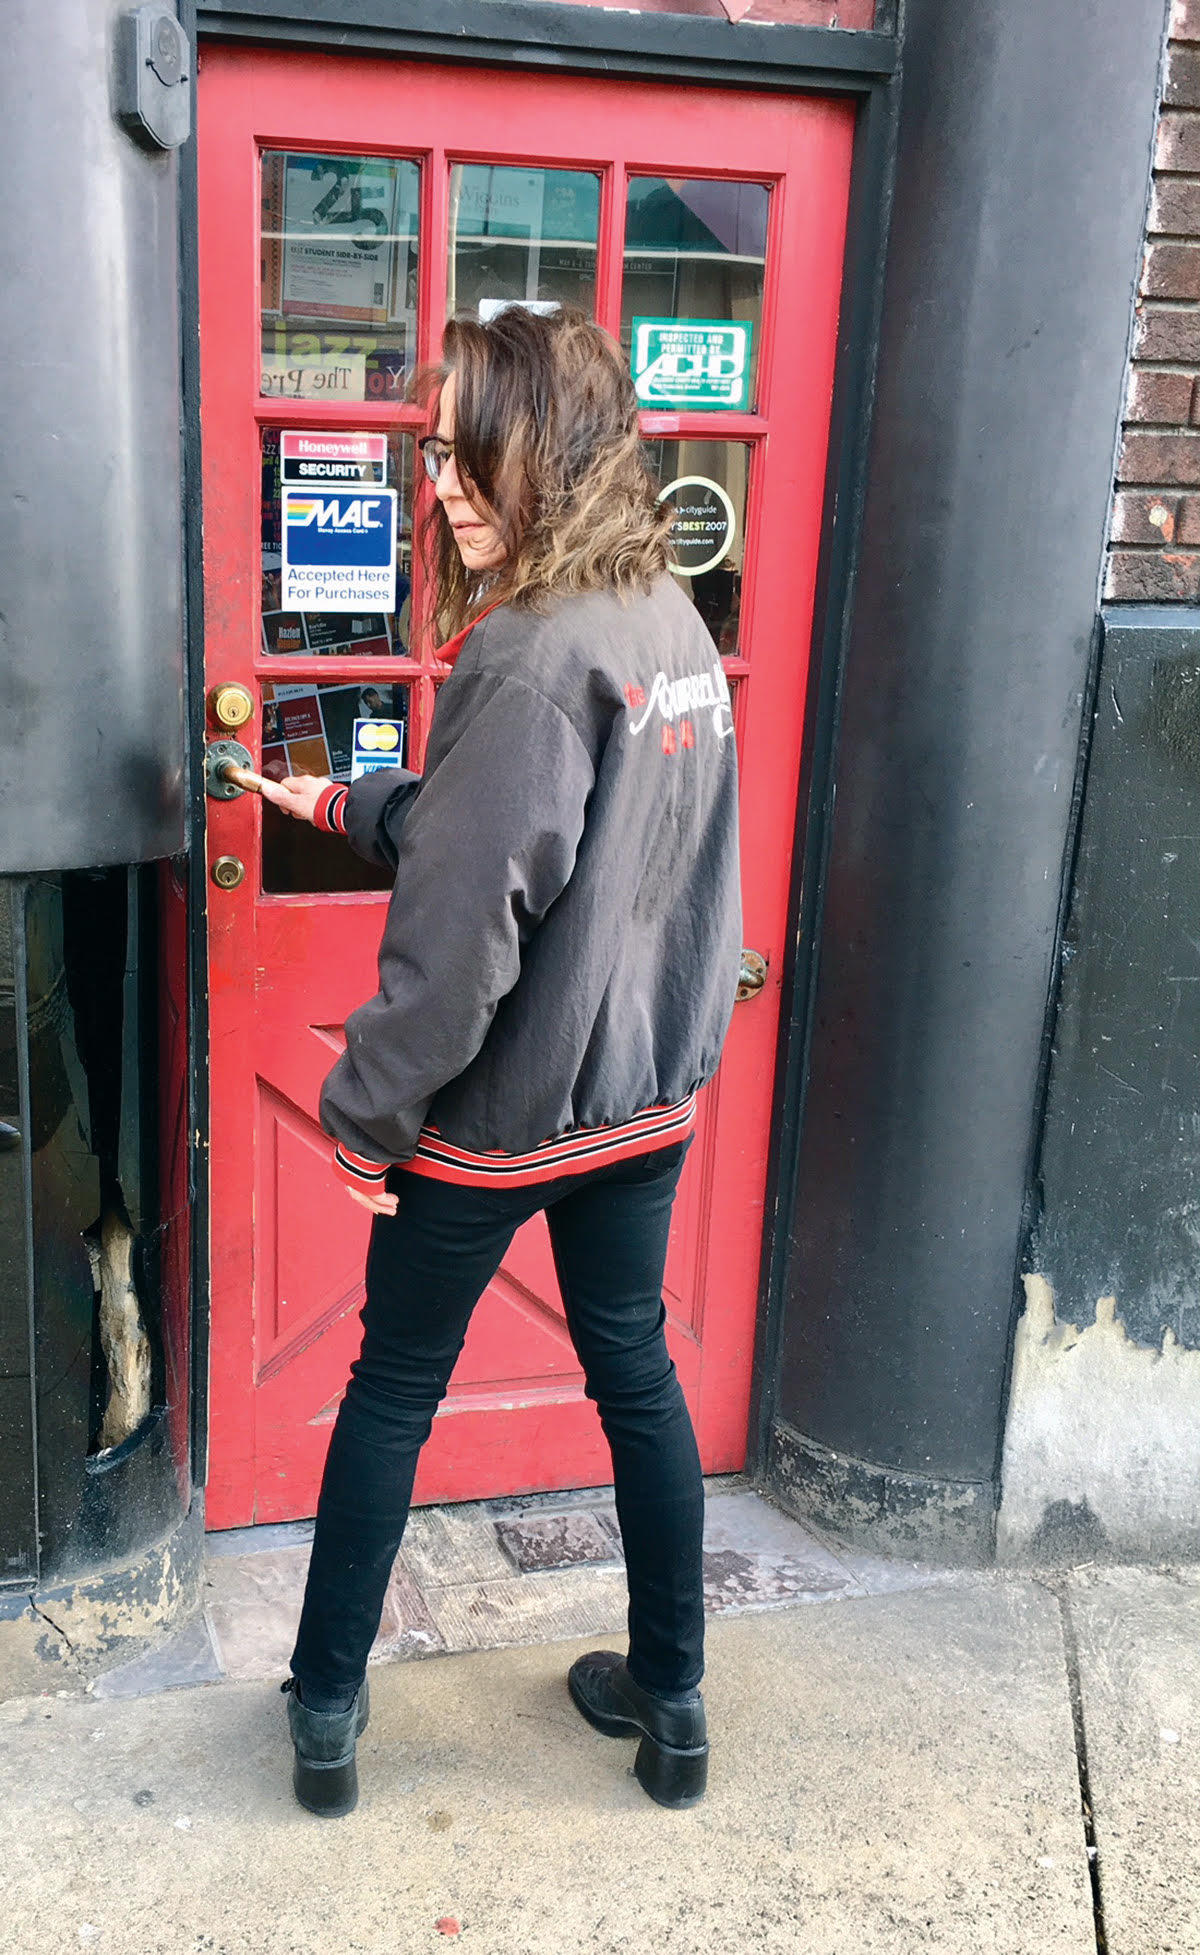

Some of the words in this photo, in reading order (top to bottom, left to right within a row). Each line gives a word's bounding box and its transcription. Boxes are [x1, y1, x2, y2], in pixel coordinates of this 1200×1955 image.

[311, 160, 388, 250] 25
[659, 332, 703, 344] INSPECTED
[707, 333, 724, 344] AND
[274, 321, 379, 371] jazz
[661, 343, 707, 354] PERMITTED
[298, 439, 368, 456] Honeywell
[298, 463, 367, 477] SECURITY
[306, 499, 382, 528] MAC
[686, 505, 718, 516] cityguide
[287, 568, 354, 583] Accepted
[358, 569, 390, 582] Here
[288, 586, 311, 599] For
[315, 586, 390, 600] Purchases
